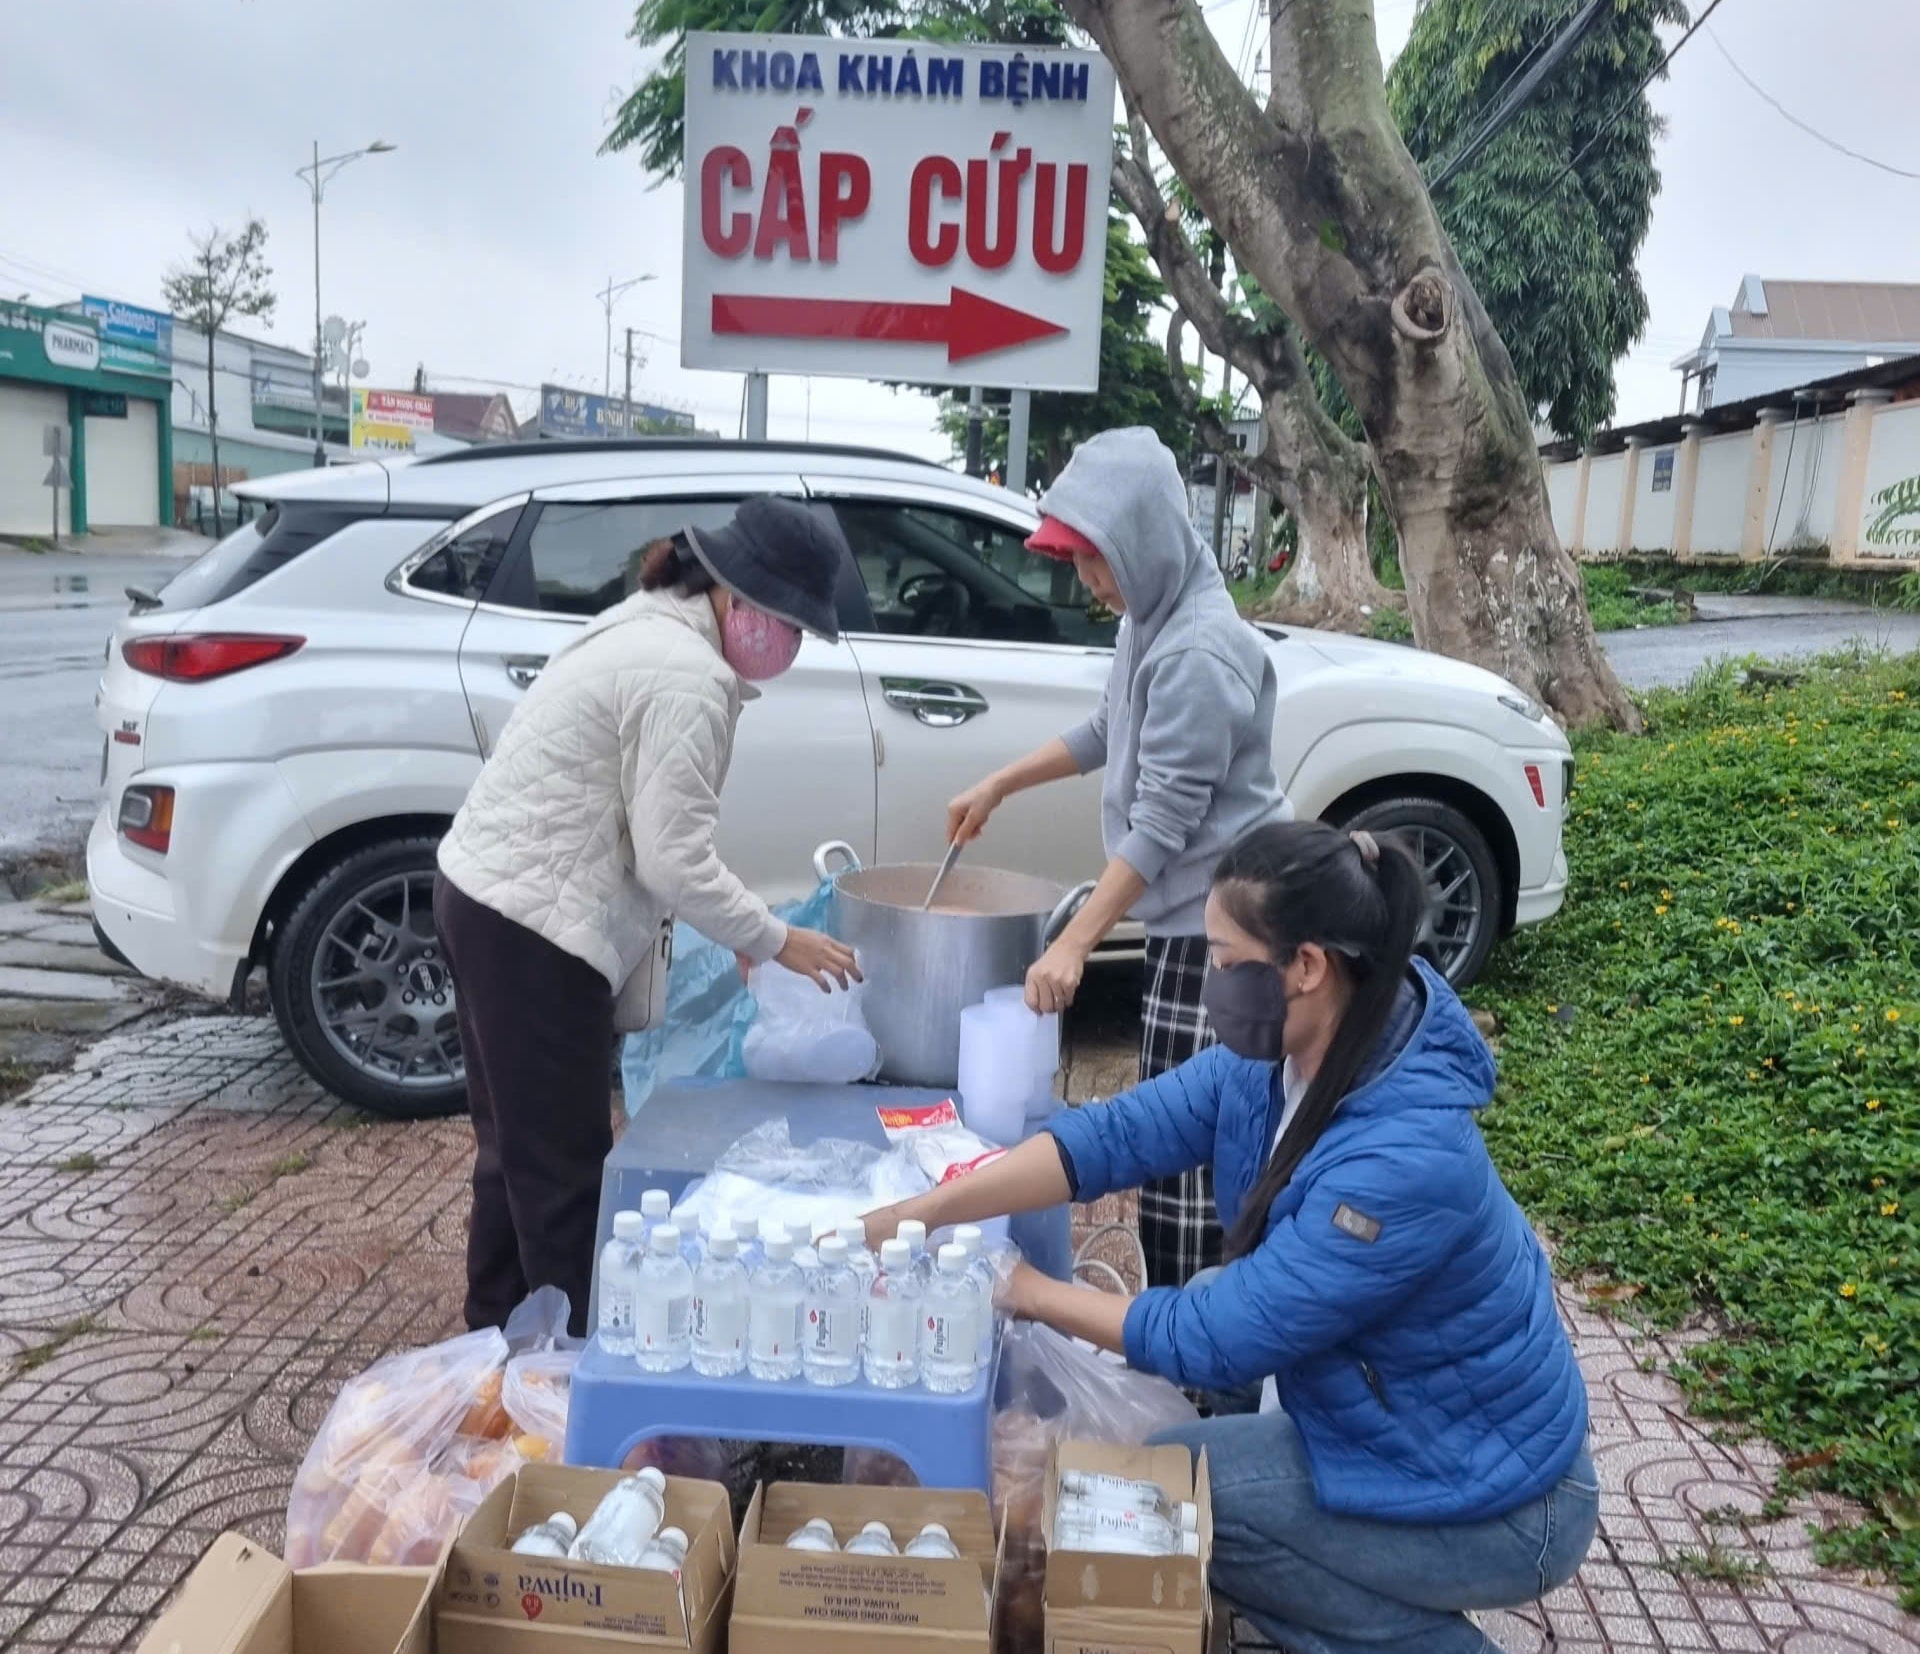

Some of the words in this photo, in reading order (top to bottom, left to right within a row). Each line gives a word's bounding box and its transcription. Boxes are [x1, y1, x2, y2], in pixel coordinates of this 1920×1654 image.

[713, 49, 823, 91] KHOA
[838, 48, 965, 97] KHÁM
[979, 52, 1090, 106] BỆNH
[701, 107, 872, 263] CẤP
[908, 131, 1089, 274] CỨU
[107, 303, 157, 333] Salonpas
[52, 333, 94, 356] PHARMACY
[418, 964, 434, 992] BBS
[1100, 1515, 1140, 1531] Fujiwa
[518, 1574, 604, 1607] Fujiwa
[863, 1598, 900, 1609] FUJIWA
[804, 1606, 828, 1618] CHAI
